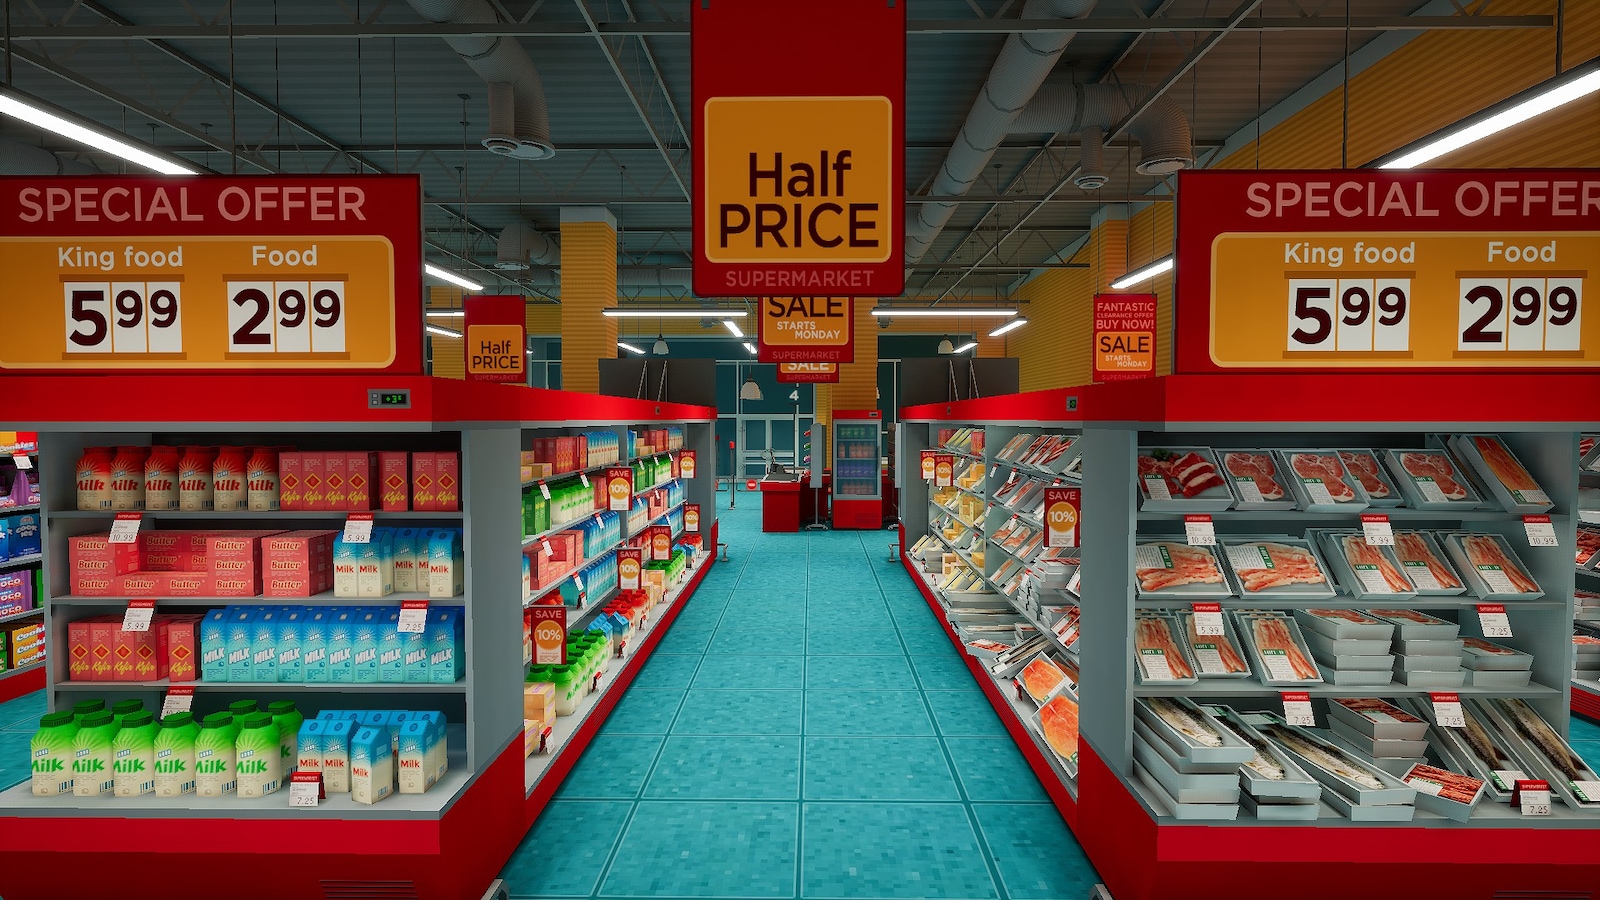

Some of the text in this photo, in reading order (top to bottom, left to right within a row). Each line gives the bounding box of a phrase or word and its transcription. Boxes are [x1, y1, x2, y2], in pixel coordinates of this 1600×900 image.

[749, 150, 852, 197] Half
[18, 186, 367, 222] SPECIAL OFFER
[1245, 181, 1439, 218] SPECIAL
[720, 203, 879, 248] PRICE
[252, 245, 317, 266] Food
[1284, 241, 1415, 268] King food
[1488, 241, 1556, 264] Food
[58, 246, 183, 271] King food
[725, 270, 874, 287] SUPERMARKET
[768, 297, 844, 318] SALE
[1097, 302, 1154, 312] FANTASTIC
[777, 321, 816, 331] STARTS
[1096, 320, 1154, 329] BUY NOW!
[795, 330, 840, 340] MONDAY
[481, 340, 511, 355] Half
[1100, 336, 1150, 353] SALE
[772, 351, 840, 360] SUPERMARKET
[473, 356, 519, 369] PRICE
[789, 389, 799, 401] 4
[609, 470, 629, 478] SAVE
[610, 483, 629, 494] 10%
[1048, 492, 1076, 500] SAVE
[1050, 511, 1075, 523] 10%
[113, 534, 133, 542] 10.99
[146, 536, 177, 545] Butter
[347, 534, 366, 542] 5.99
[1191, 536, 1213, 544] 10.99
[1532, 537, 1555, 545] 10.99
[77, 540, 107, 550] Butter
[215, 541, 245, 550] Butter
[270, 541, 301, 550] Butter
[78, 560, 108, 569] Butter
[147, 555, 177, 565] Butter
[216, 560, 246, 570] Butter
[271, 560, 301, 570] Butter
[395, 561, 413, 569] Milk
[336, 565, 354, 573] Milk
[359, 565, 378, 573] Milk
[431, 565, 449, 573] Milk
[620, 565, 638, 573] 10%
[78, 580, 109, 589] Butter
[124, 580, 154, 589] Butter
[170, 580, 200, 589] Butter
[216, 580, 246, 590] Butter
[271, 580, 302, 590] Butter
[535, 610, 562, 619] SAVE
[127, 622, 145, 630] 5.99
[1200, 627, 1219, 635] 5.99
[536, 629, 561, 640] 10%
[203, 647, 225, 665] MILK
[228, 647, 250, 665] MILK
[253, 647, 276, 665] MILK
[279, 647, 301, 665] MILK
[304, 647, 326, 665] MILK
[329, 647, 351, 665] MILK
[355, 647, 377, 665] MILK
[380, 647, 402, 665] MILK
[405, 647, 427, 665] MILK
[430, 647, 452, 665] MILK
[1444, 717, 1462, 725] 7.25
[300, 758, 319, 767] Milk
[325, 758, 344, 767] Milk
[401, 759, 420, 768] Milk
[353, 766, 369, 777] Milk
[297, 797, 314, 805] 7.25
[1530, 805, 1548, 814] 7.25
